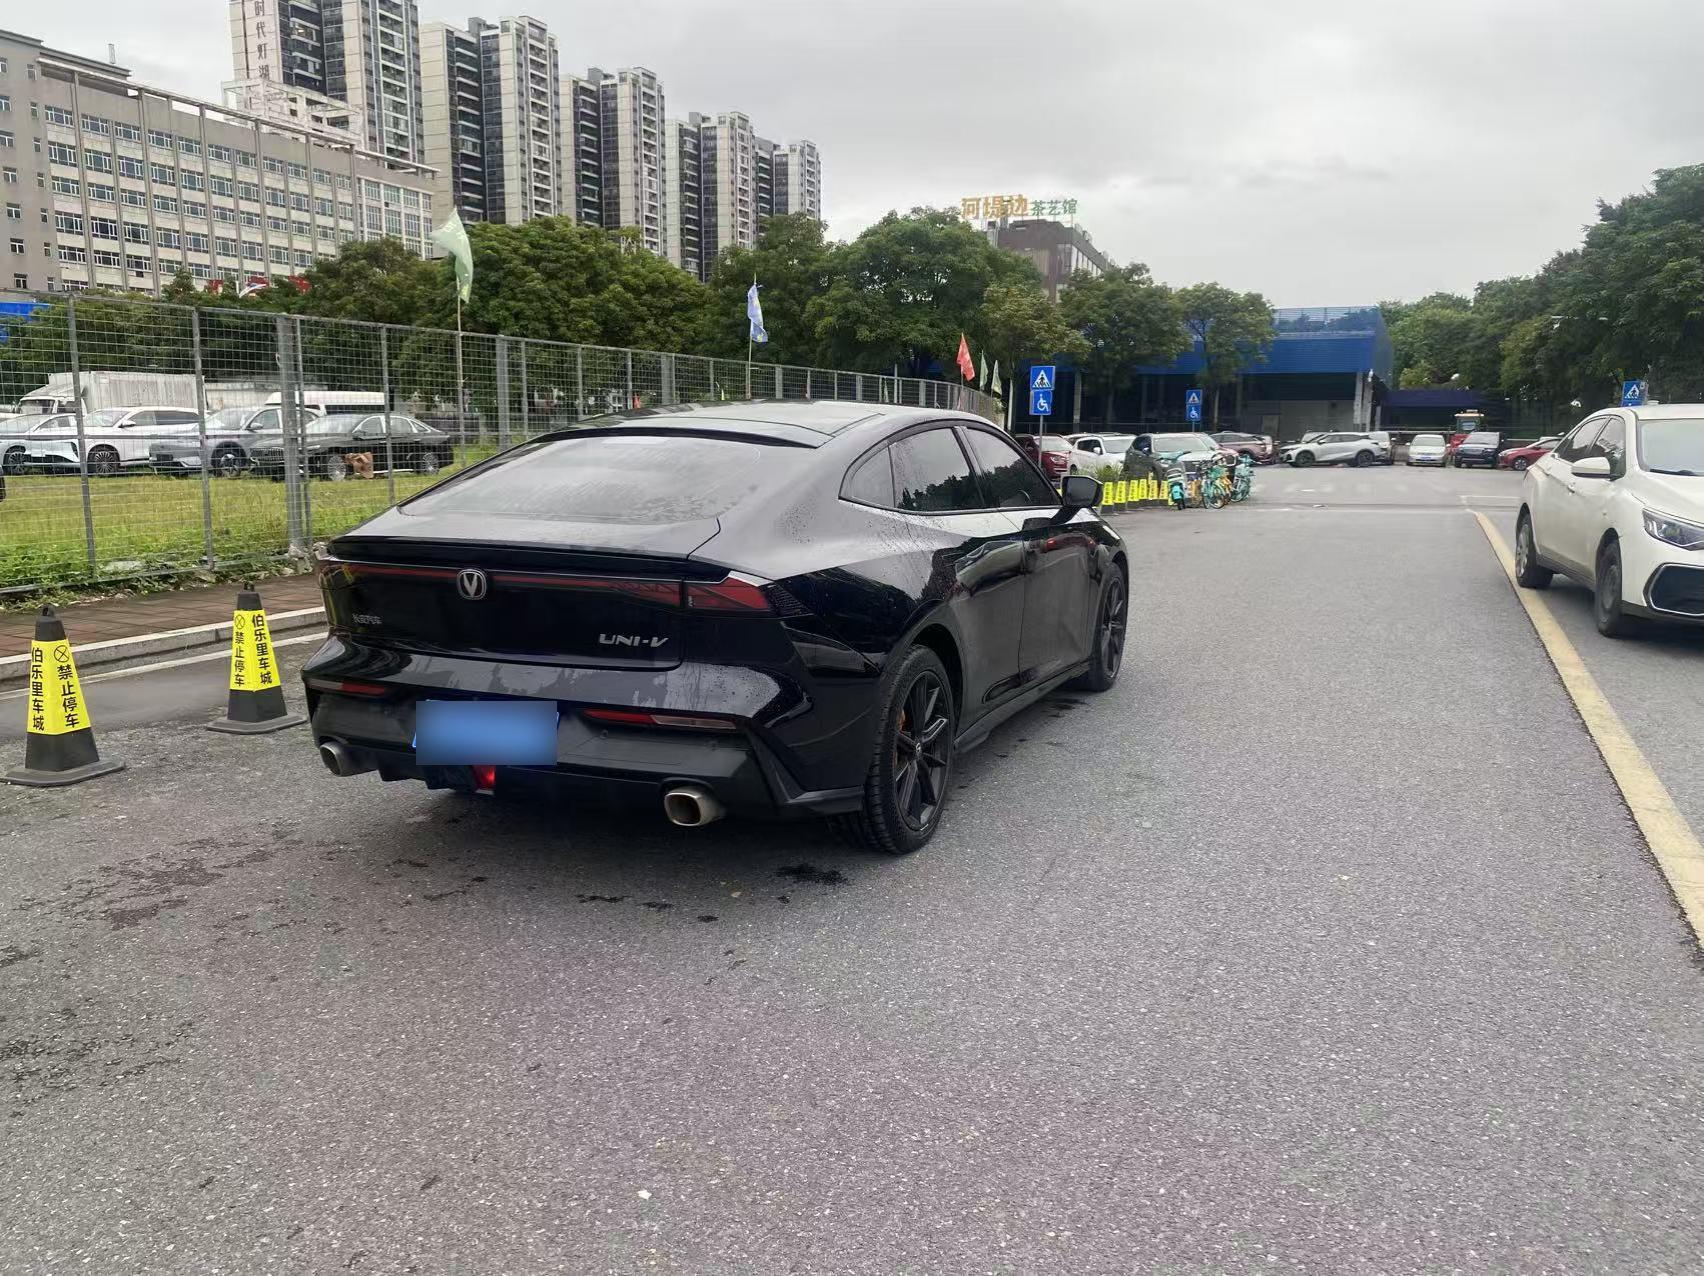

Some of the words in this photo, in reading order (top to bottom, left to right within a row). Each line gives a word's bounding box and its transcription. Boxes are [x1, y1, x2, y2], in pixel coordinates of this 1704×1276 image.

[1031, 198, 1078, 216] 茶艺馆
[234, 631, 245, 687] 禁止停车
[252, 613, 272, 685] 伯乐里车城
[599, 633, 669, 648] UNI-V
[31, 647, 45, 731] 伯乐里车城
[57, 663, 80, 728] 禁止停车
